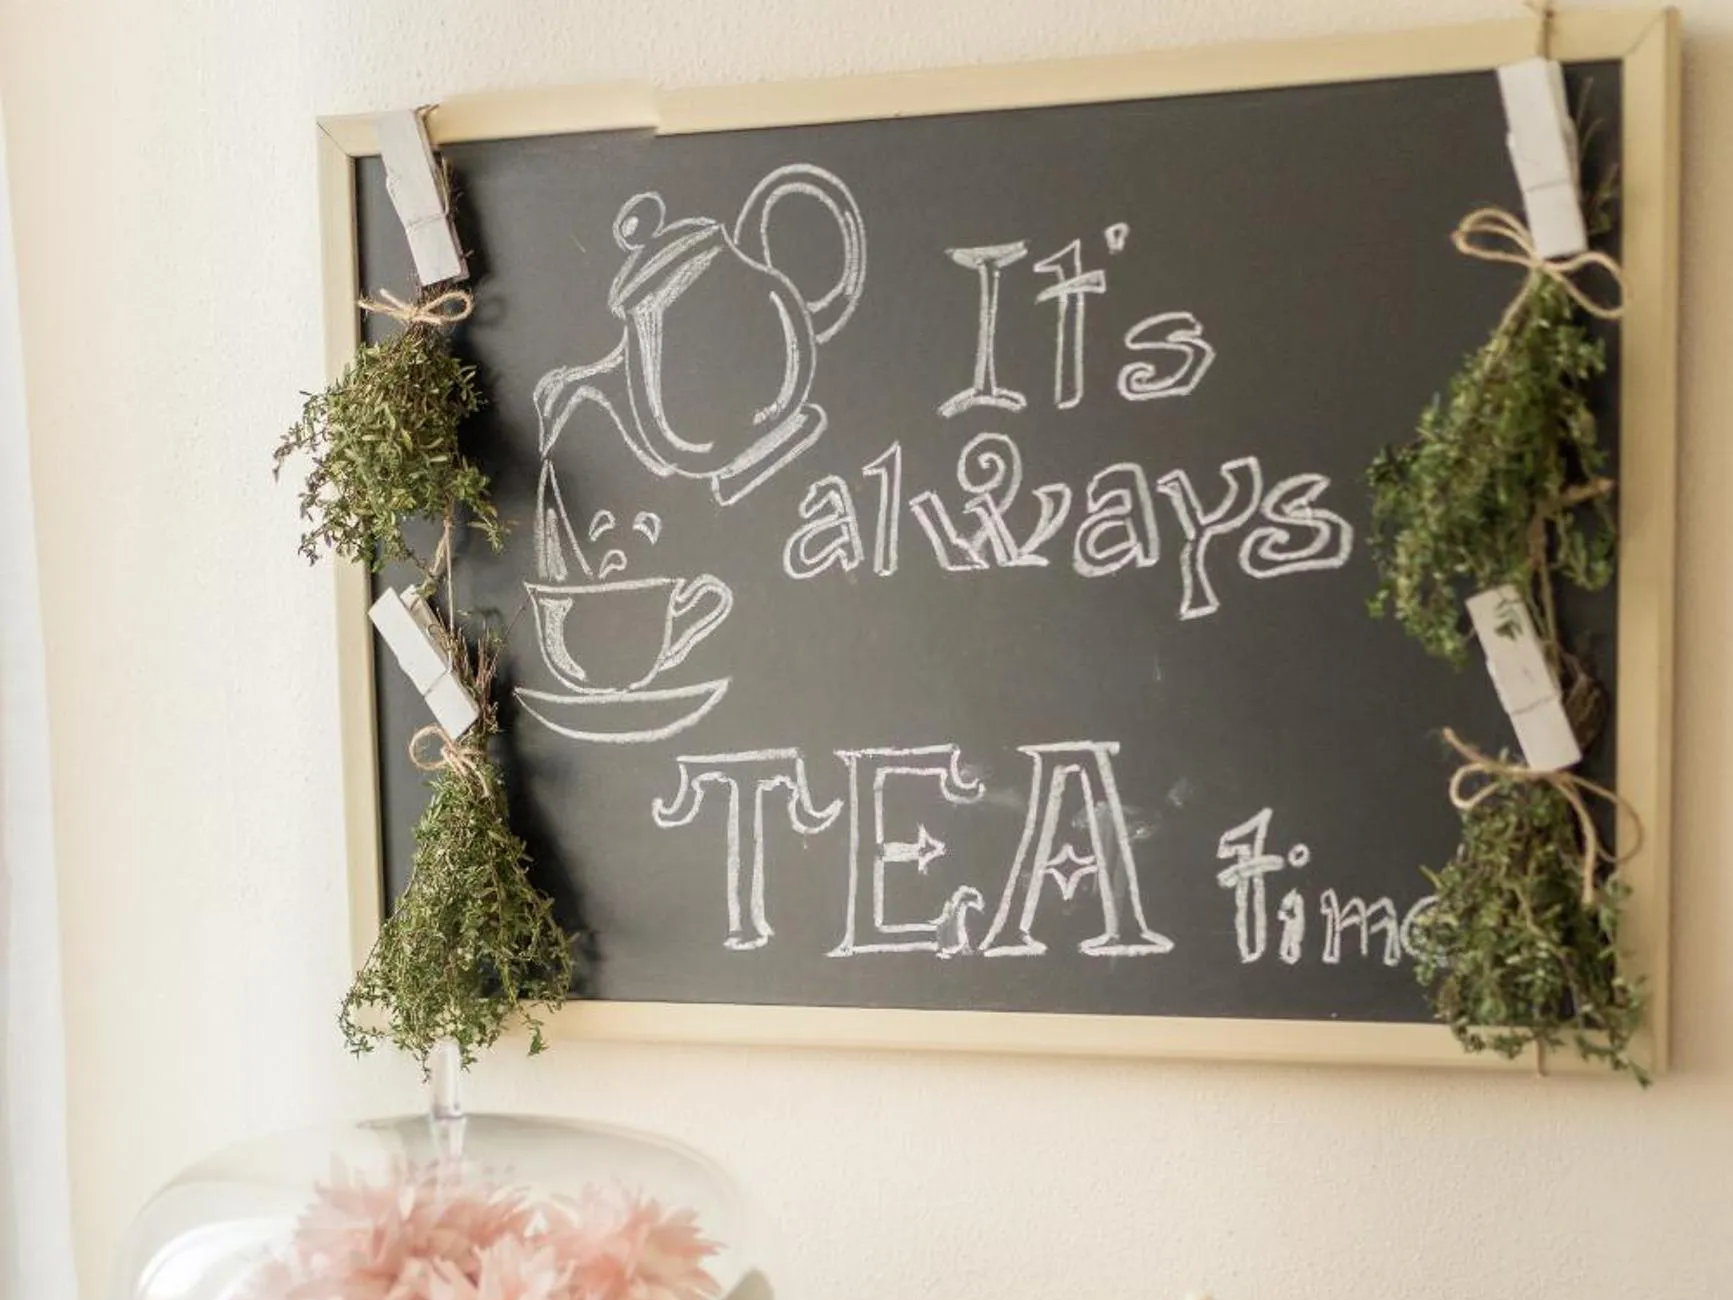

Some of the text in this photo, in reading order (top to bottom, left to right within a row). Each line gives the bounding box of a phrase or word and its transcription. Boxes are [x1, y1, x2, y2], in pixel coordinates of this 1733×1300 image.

[938, 222, 1217, 418] It's
[782, 432, 1354, 620] always
[651, 740, 1176, 958] TEA
